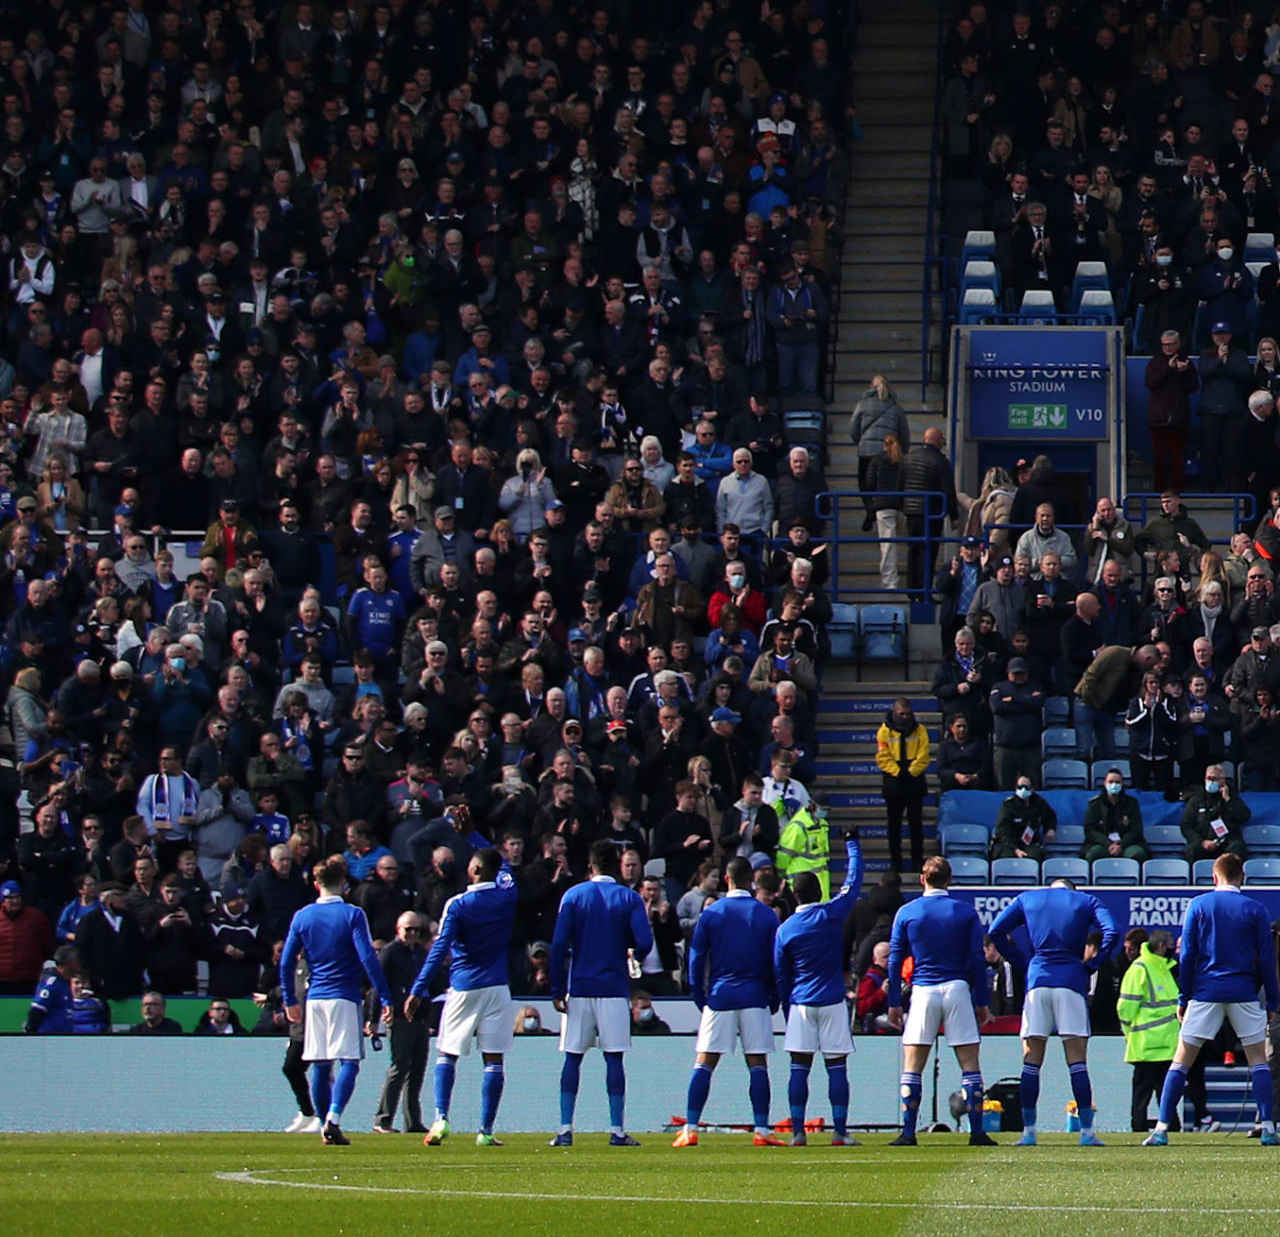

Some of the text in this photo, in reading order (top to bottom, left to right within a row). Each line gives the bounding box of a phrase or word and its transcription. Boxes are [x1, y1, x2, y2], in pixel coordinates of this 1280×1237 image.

[974, 363, 1102, 379] KING POWER
[1009, 381, 1066, 393] STADIUM
[1011, 409, 1028, 417] Fire
[1075, 408, 1103, 421] V10
